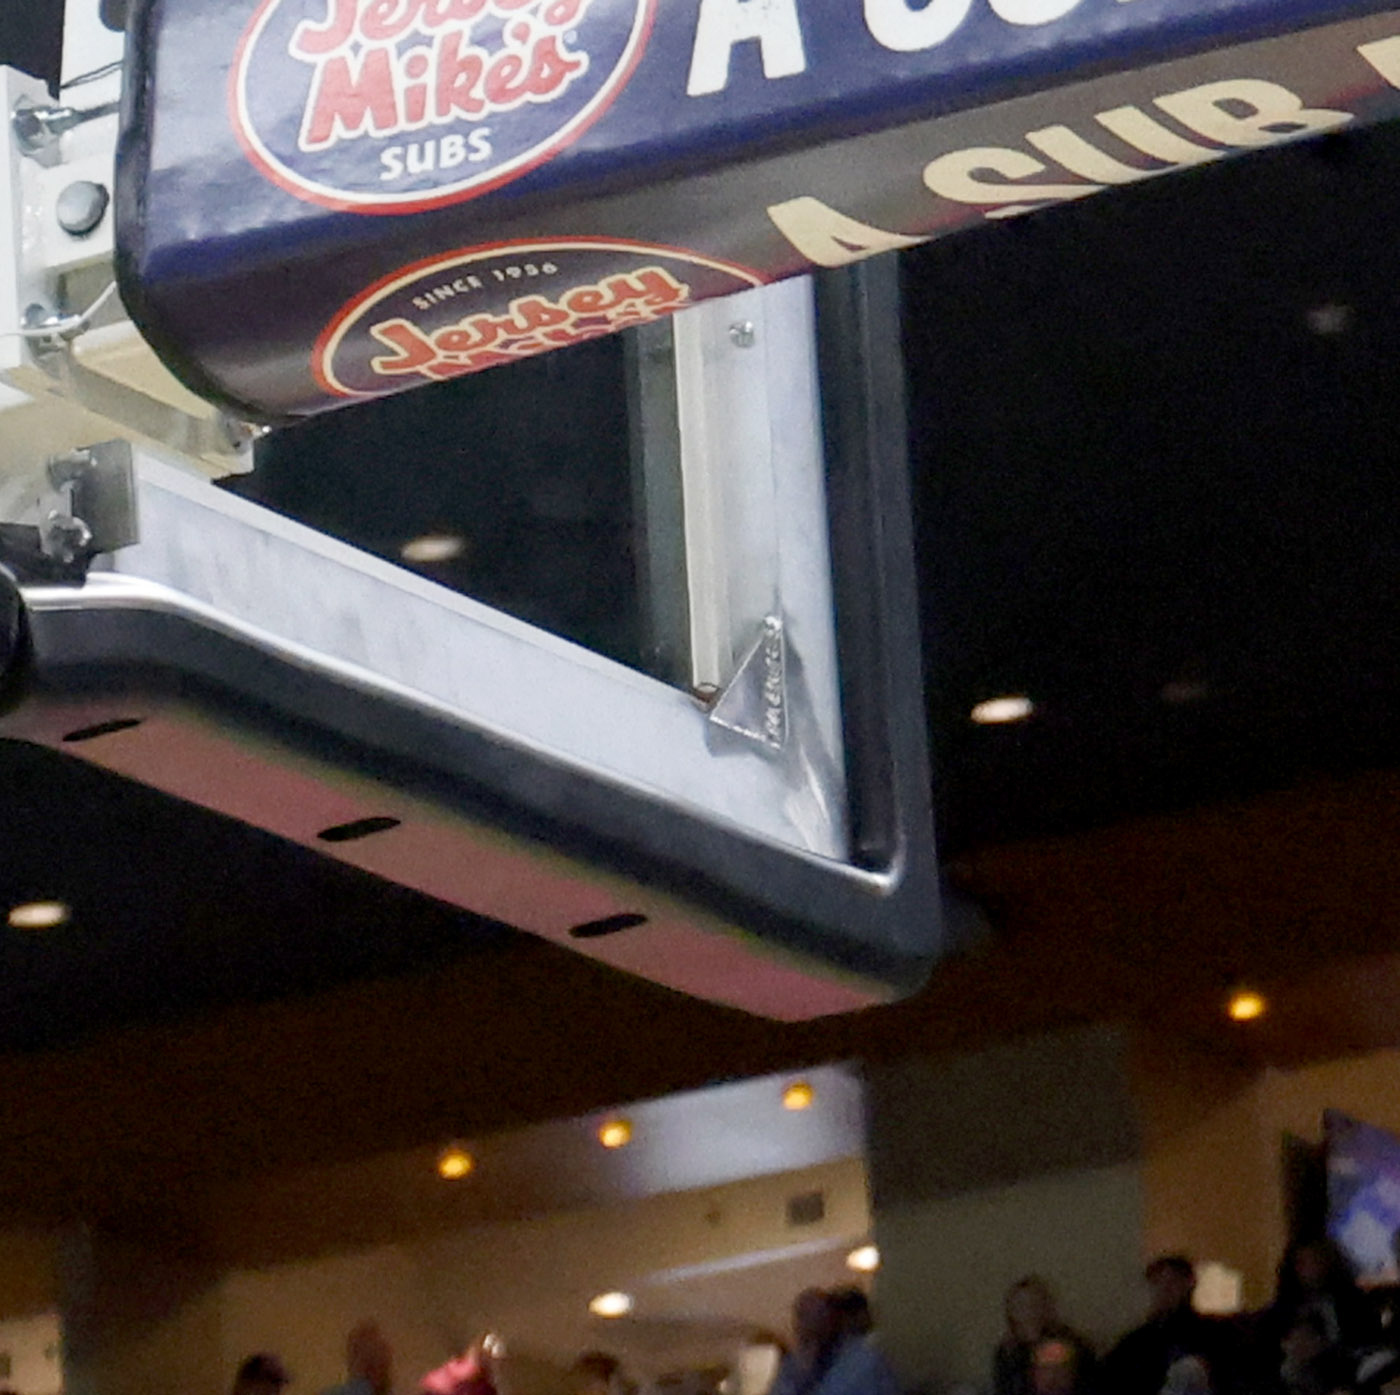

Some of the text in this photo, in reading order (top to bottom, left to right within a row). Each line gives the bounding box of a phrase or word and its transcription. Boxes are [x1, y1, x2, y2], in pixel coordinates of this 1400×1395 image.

[298, 27, 590, 153] Mike's
[379, 126, 494, 181] SUBS
[924, 79, 1355, 219] SUB
[370, 266, 689, 375] Jersey
[412, 278, 483, 310] SINCE
